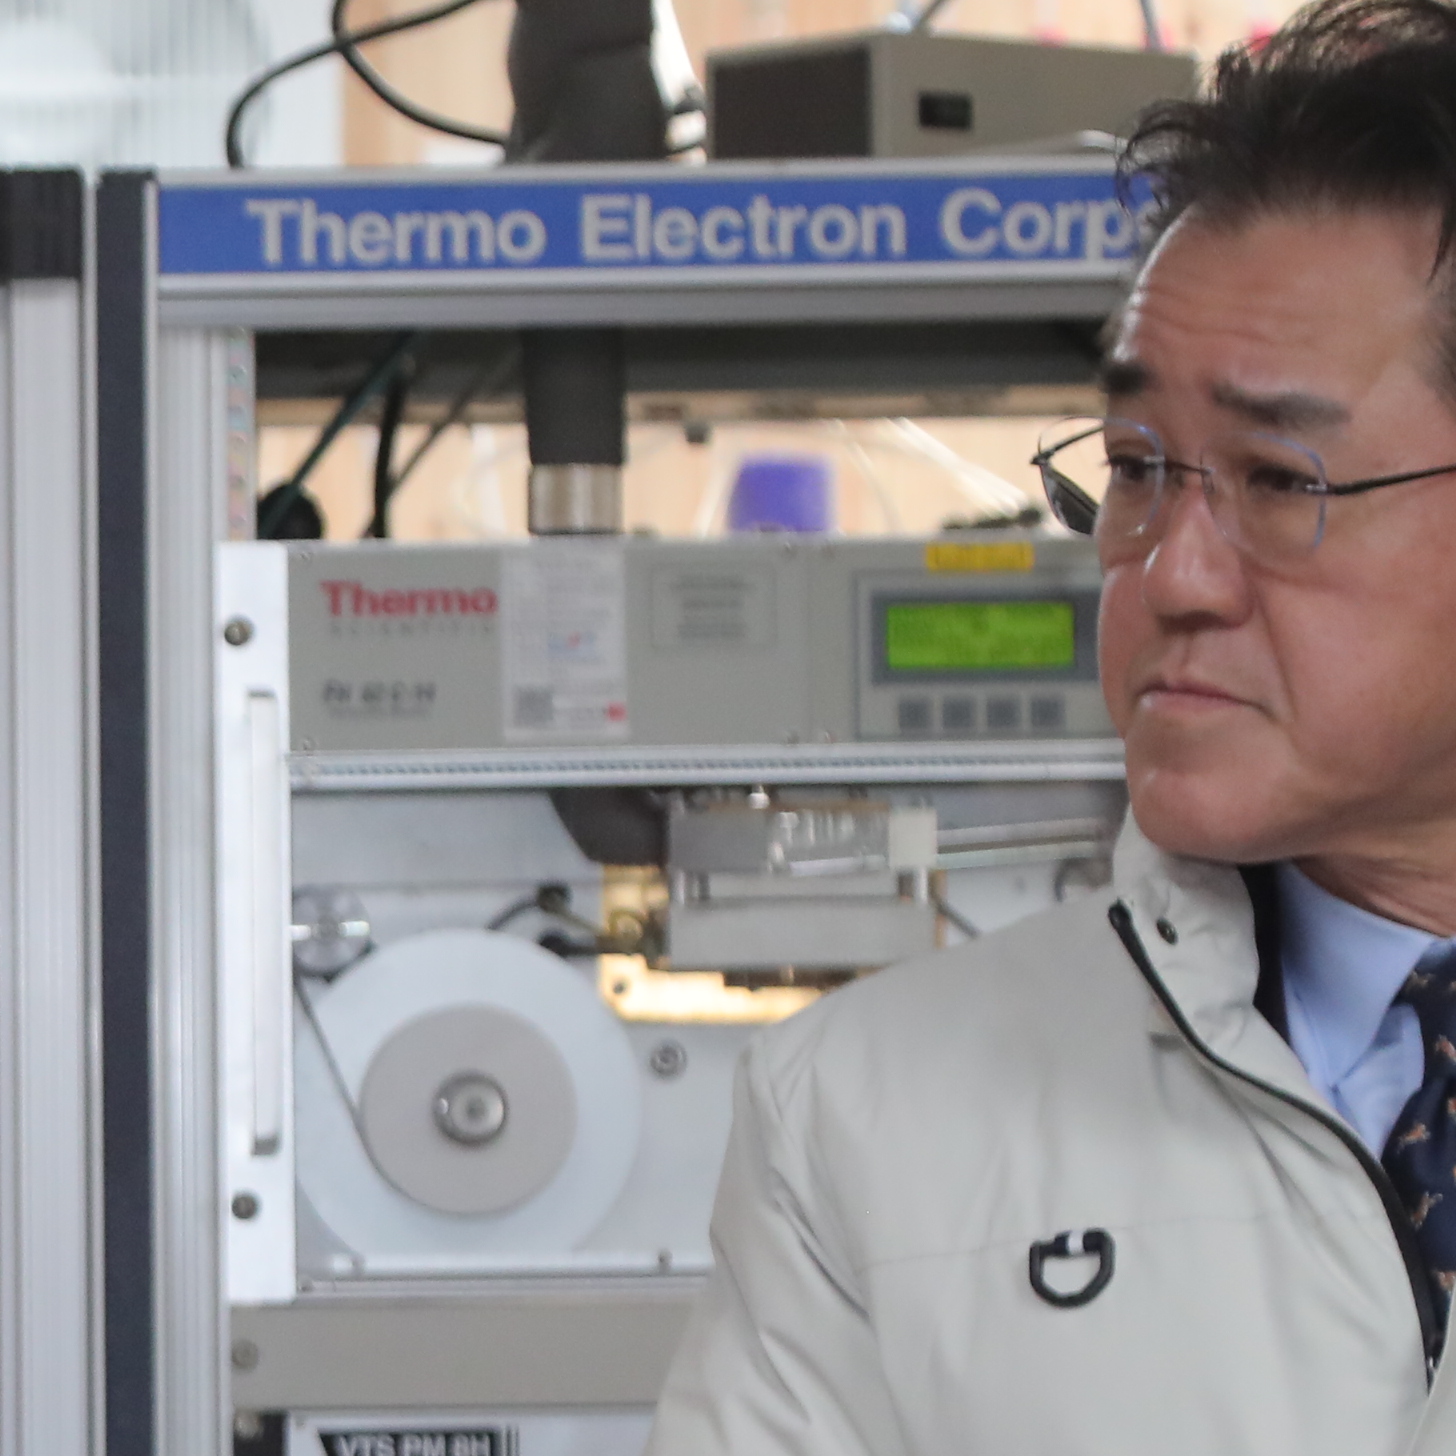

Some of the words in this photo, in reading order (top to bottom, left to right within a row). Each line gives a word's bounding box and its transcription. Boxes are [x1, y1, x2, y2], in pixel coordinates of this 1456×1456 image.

[246, 198, 547, 264] Thermo
[581, 194, 907, 261] Electron
[320, 578, 499, 617] Thermo
